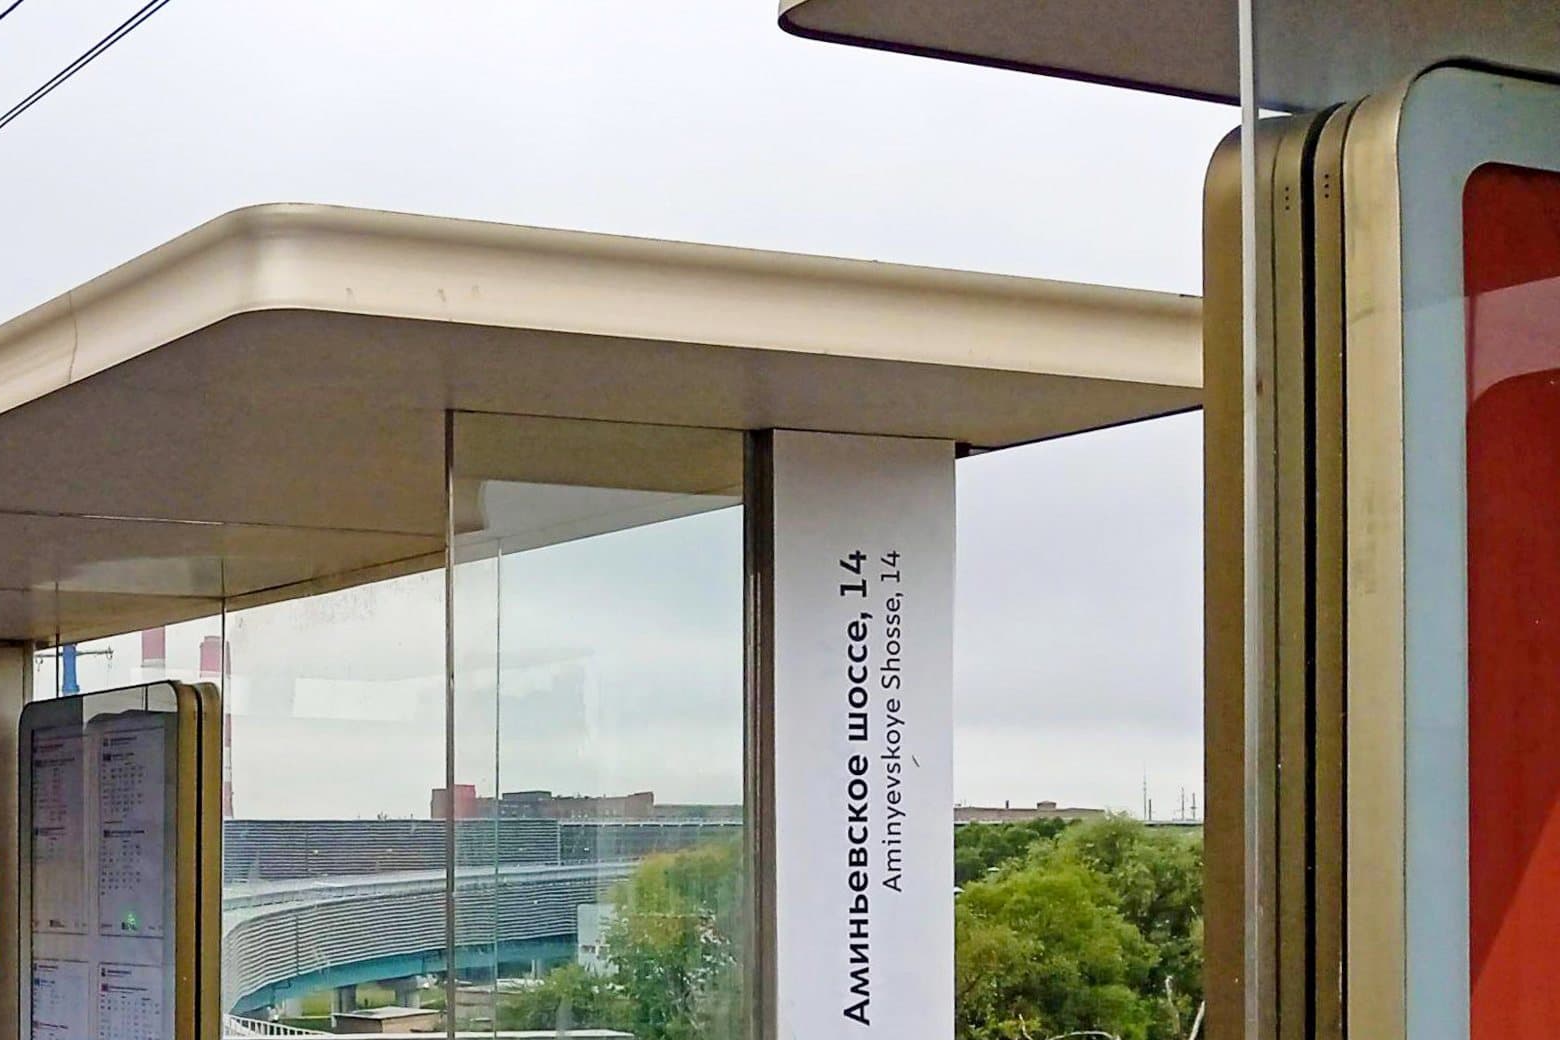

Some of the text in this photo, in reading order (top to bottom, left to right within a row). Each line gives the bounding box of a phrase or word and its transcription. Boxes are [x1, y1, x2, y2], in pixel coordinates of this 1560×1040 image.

[840, 548, 872, 1027] Аминьевское шоссе, 14
[881, 549, 906, 893] Aminyevskoye Shosse, 14
